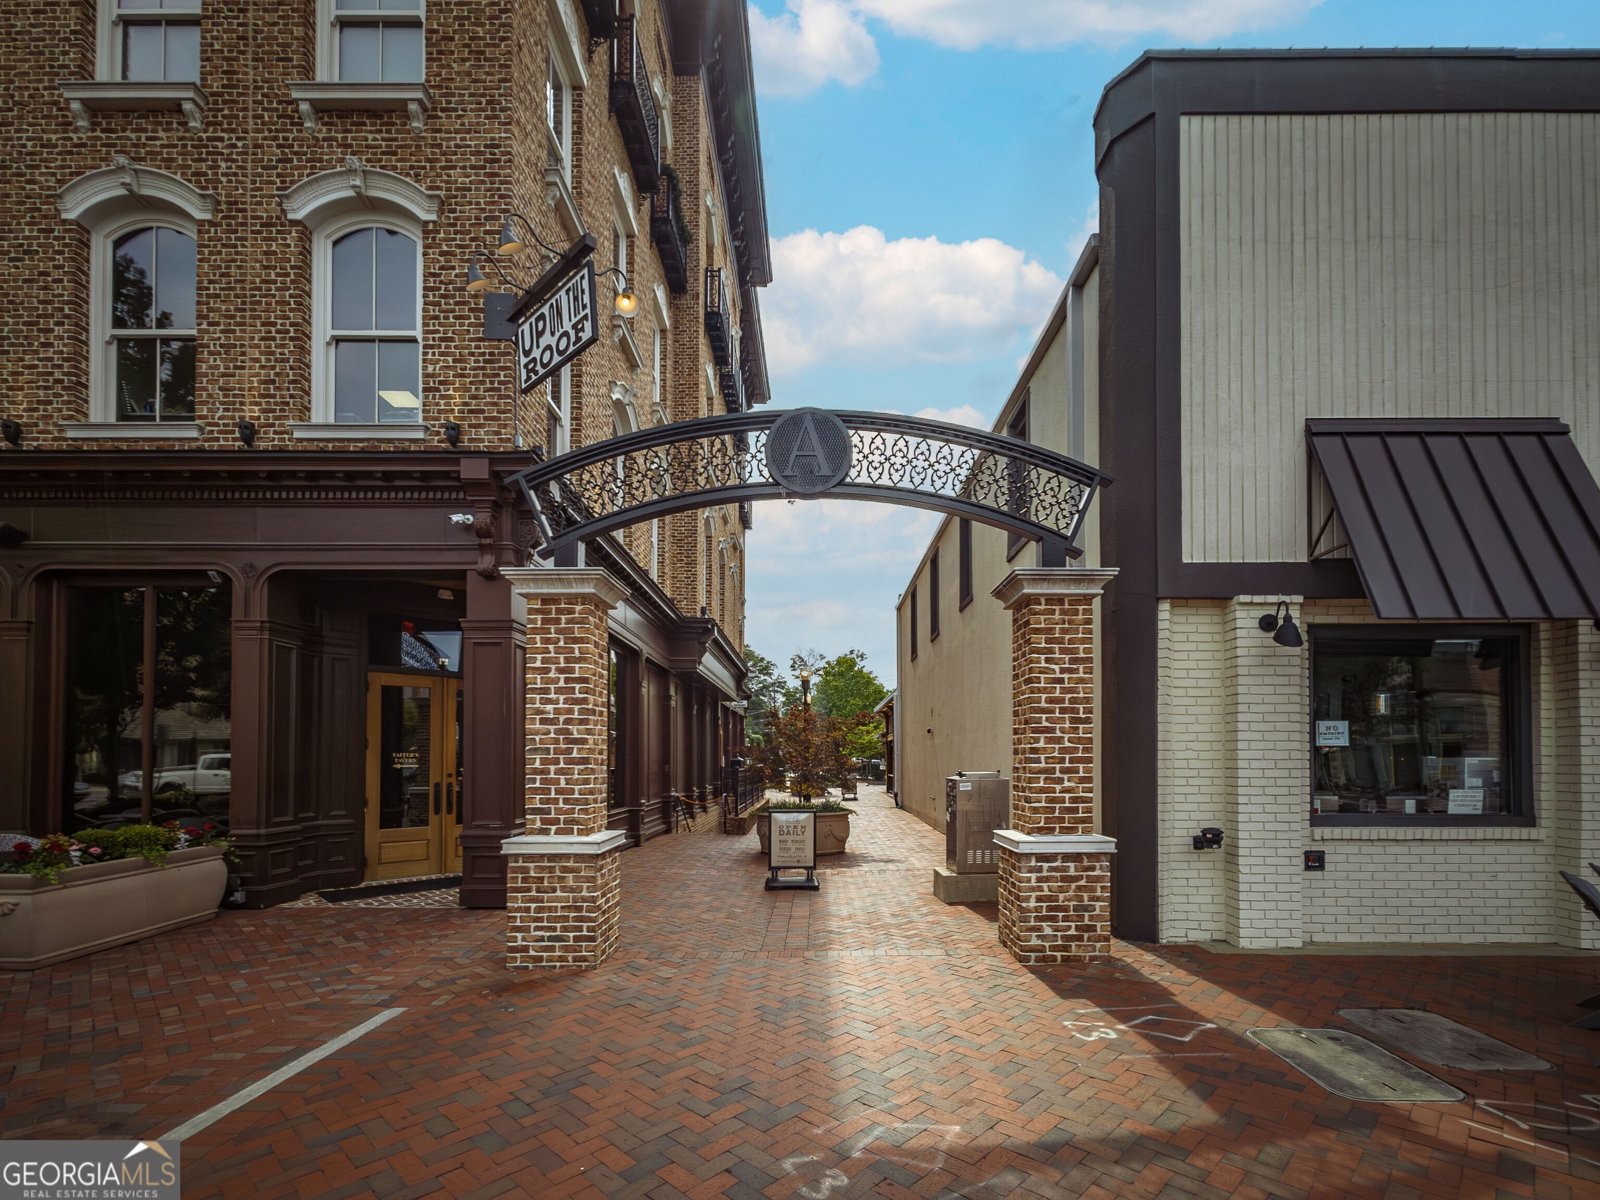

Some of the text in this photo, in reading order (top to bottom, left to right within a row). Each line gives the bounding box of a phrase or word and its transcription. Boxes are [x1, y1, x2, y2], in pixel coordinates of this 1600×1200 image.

[520, 273, 588, 358] UP ON THE
[523, 312, 590, 385] ROOF
[780, 411, 838, 477] A
[778, 829, 807, 837] DAILY
